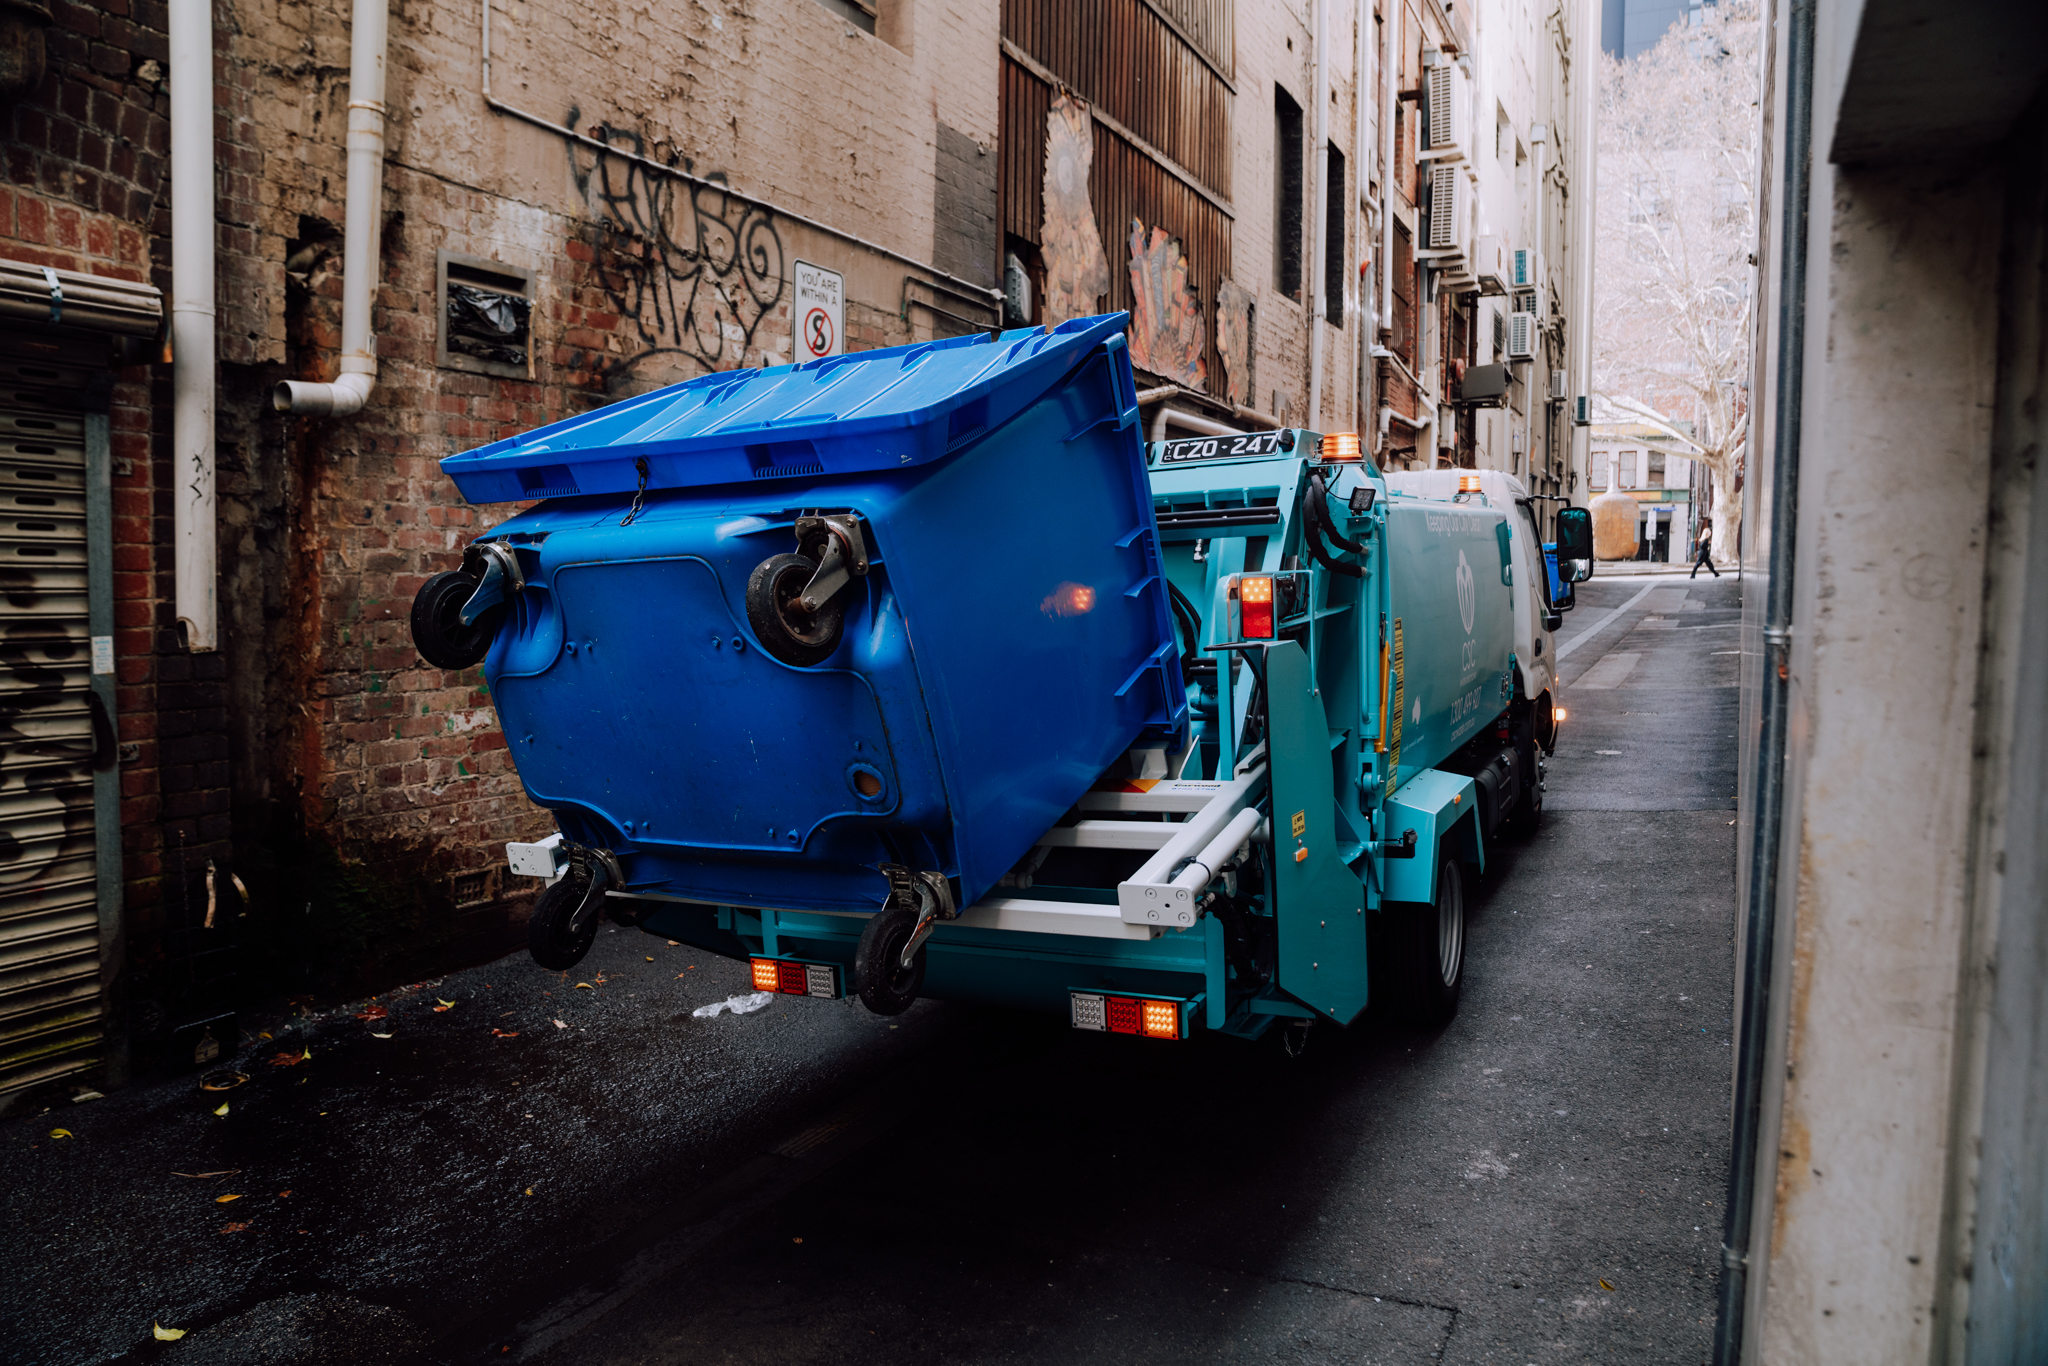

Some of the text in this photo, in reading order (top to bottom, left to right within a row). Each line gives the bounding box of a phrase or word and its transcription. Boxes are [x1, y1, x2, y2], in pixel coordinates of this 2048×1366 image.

[800, 271, 838, 293] YOU ARE
[800, 286, 838, 307] WITHIN A
[1424, 510, 1482, 538] Keeping Our City Clean
[1462, 638, 1476, 672] CSC
